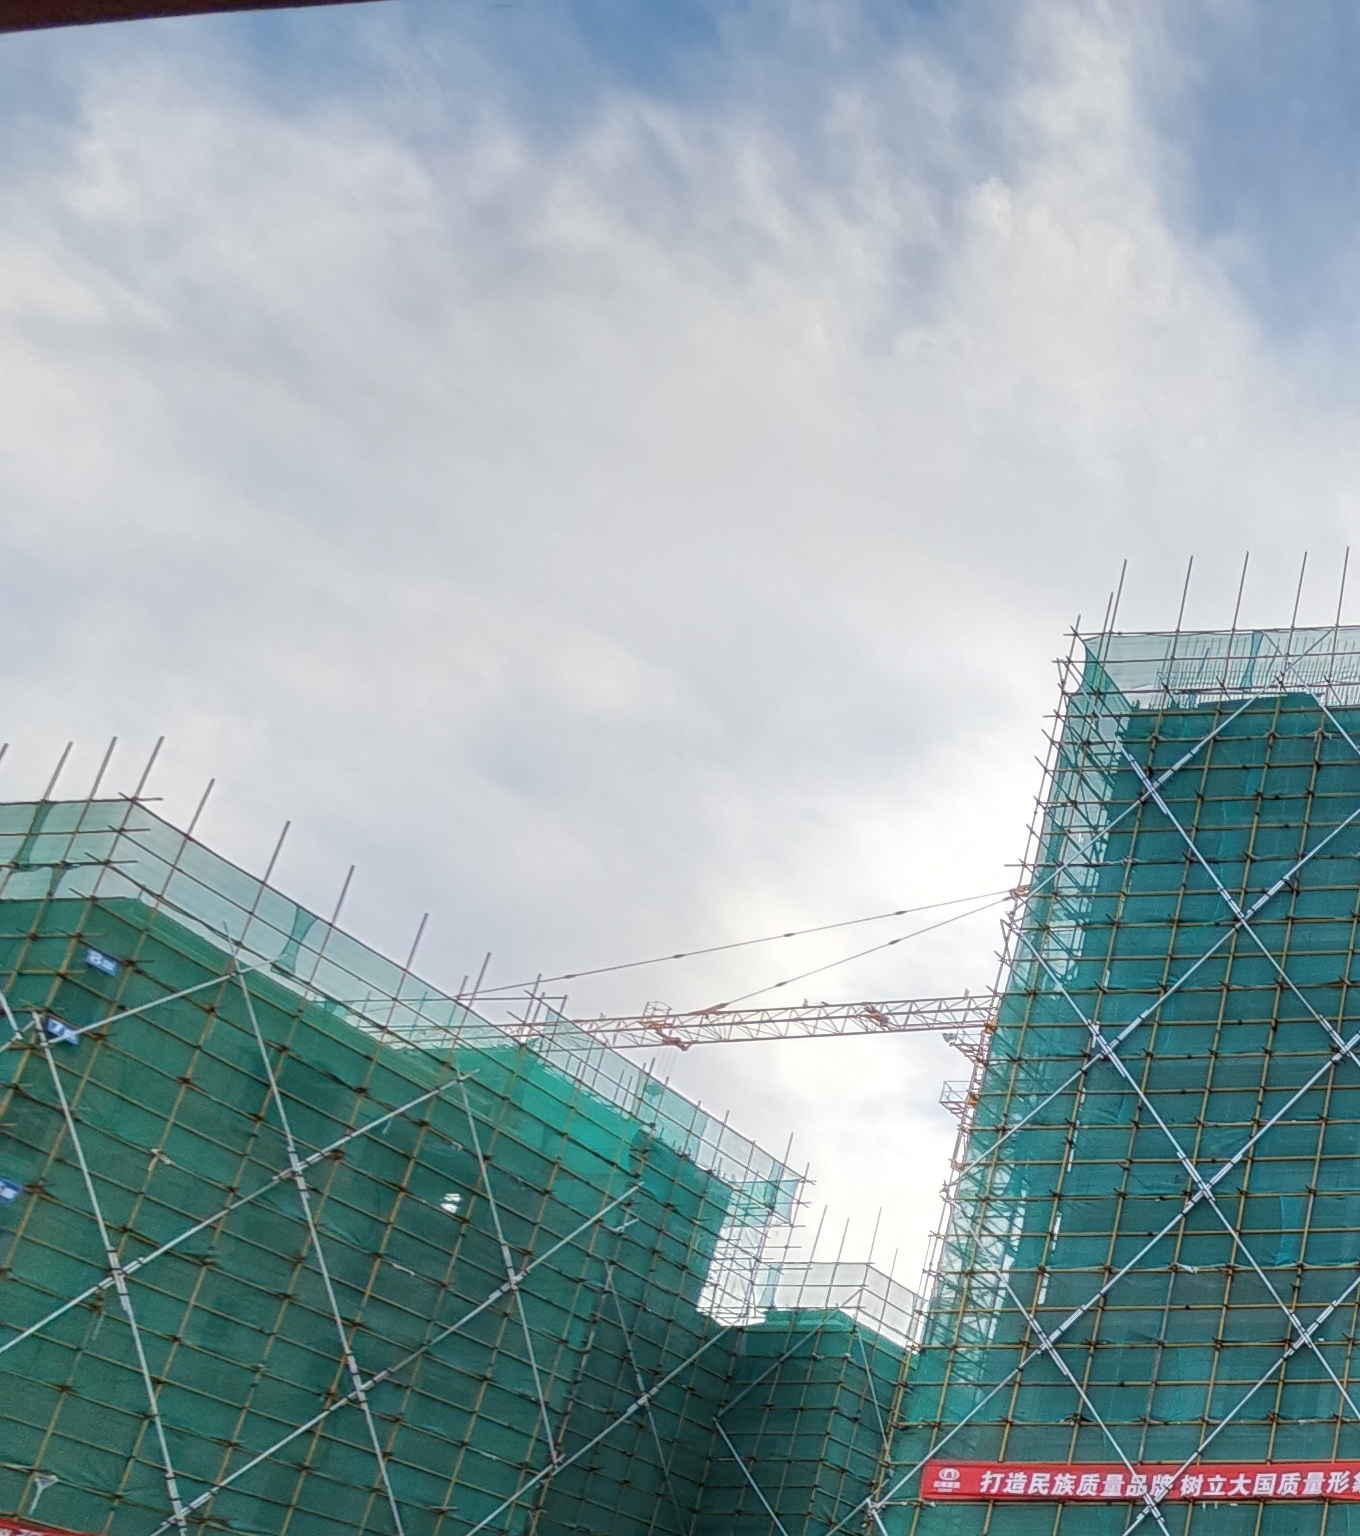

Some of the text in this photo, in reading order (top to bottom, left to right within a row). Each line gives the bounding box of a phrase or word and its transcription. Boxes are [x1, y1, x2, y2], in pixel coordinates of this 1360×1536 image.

[980, 1470, 1174, 1497] 打造民族质量品牌
